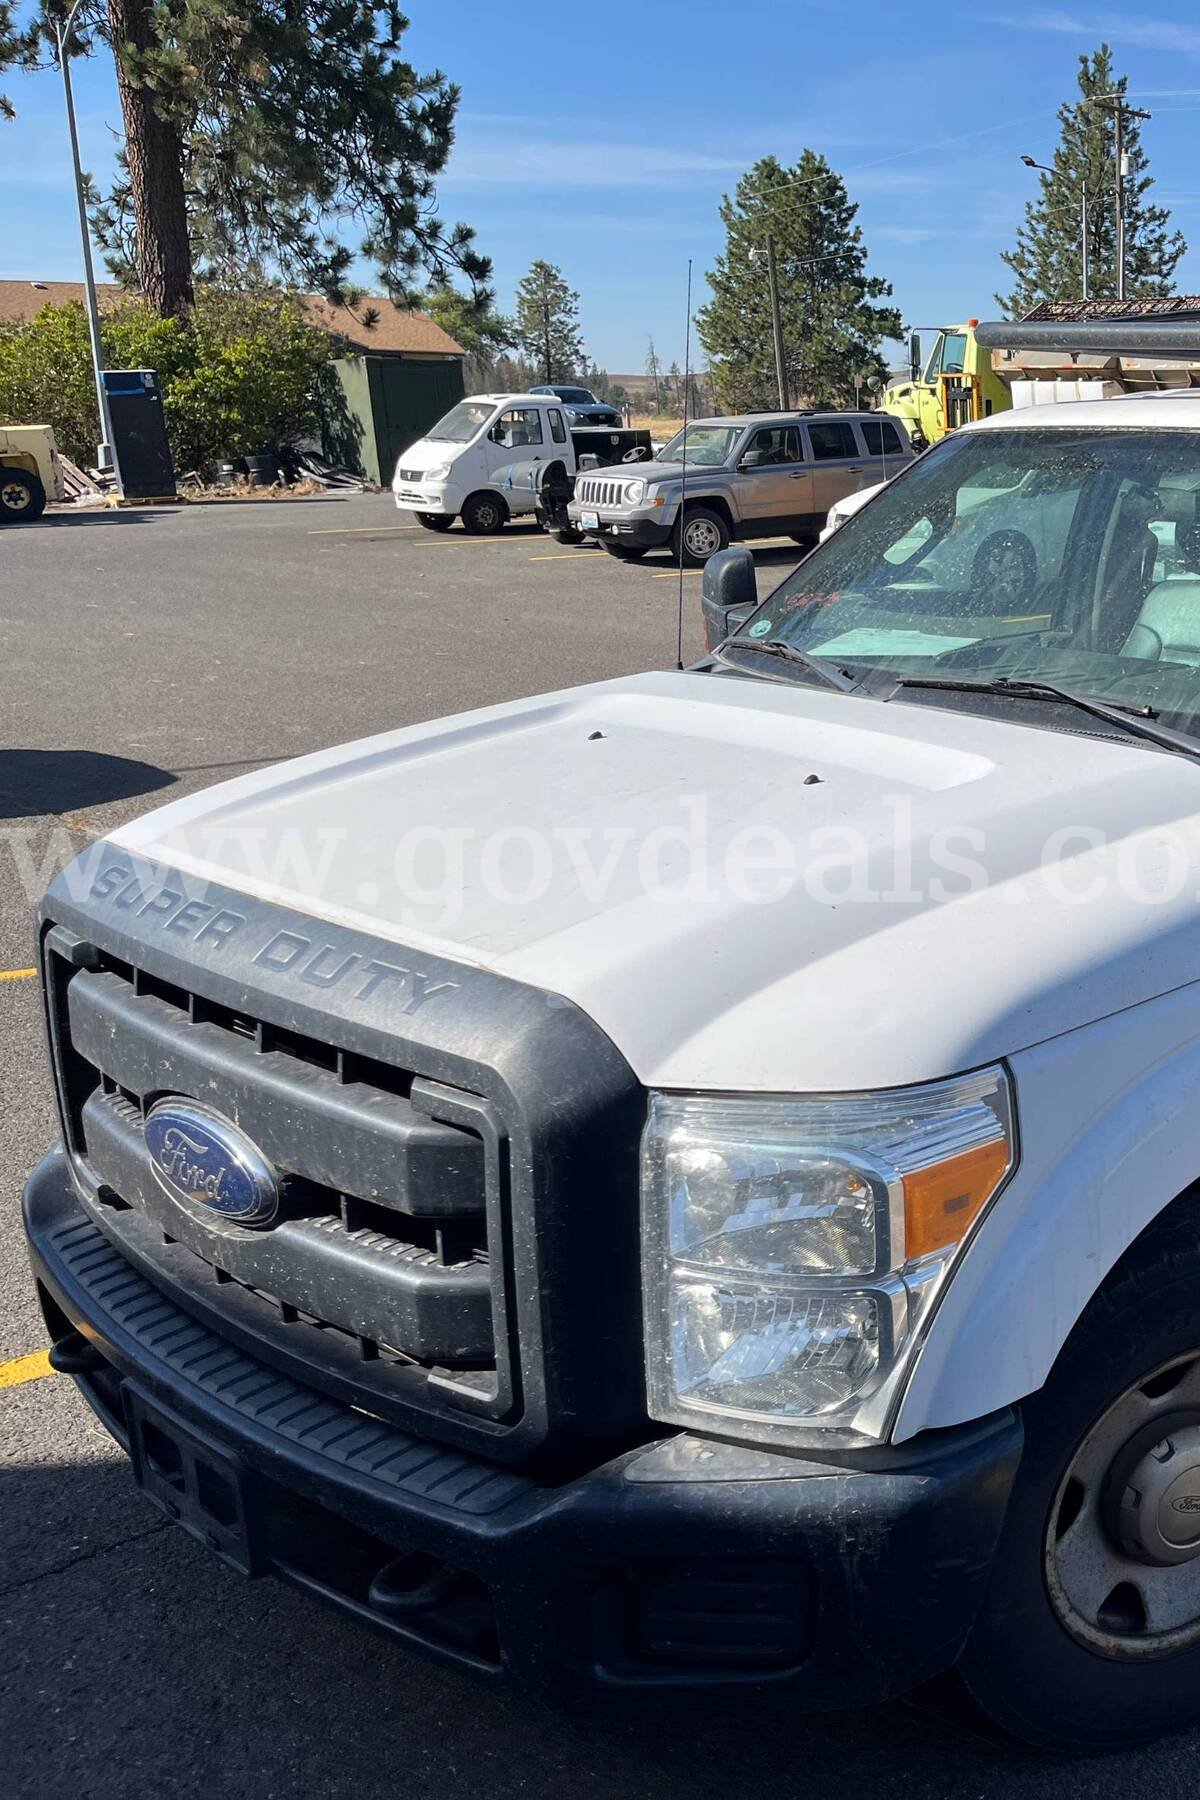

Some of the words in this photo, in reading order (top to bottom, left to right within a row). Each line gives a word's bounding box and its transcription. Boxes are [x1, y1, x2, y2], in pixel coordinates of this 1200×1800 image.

[89, 865, 247, 949] SUPER
[251, 929, 462, 1016] DUTY
[161, 1127, 225, 1201] Ford
